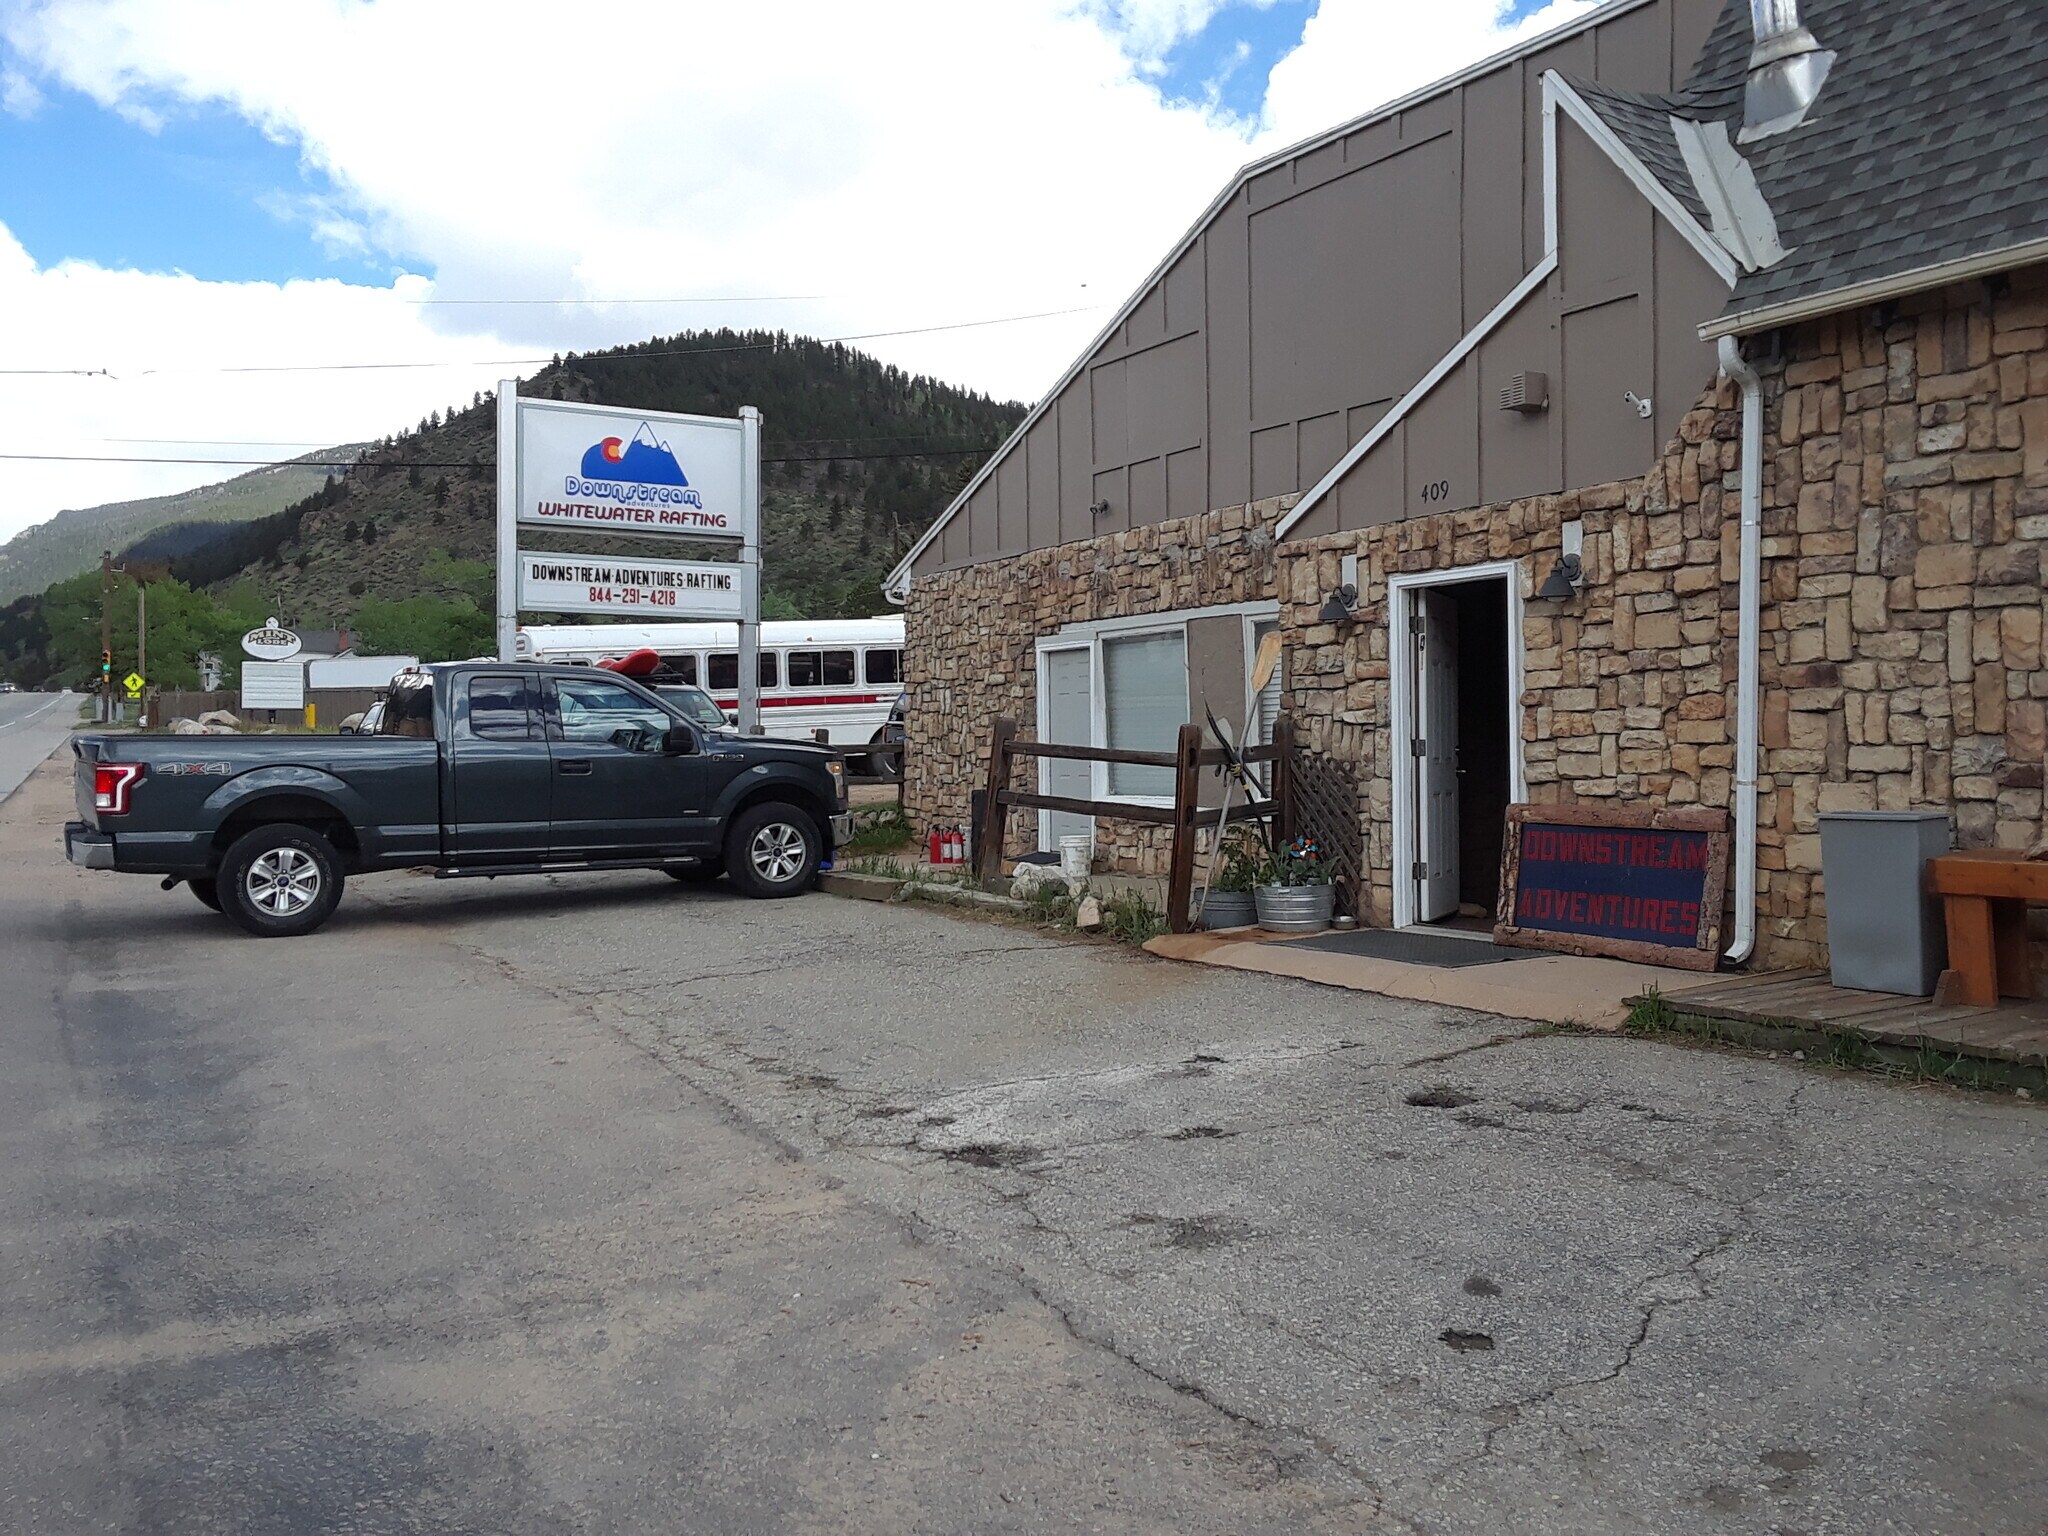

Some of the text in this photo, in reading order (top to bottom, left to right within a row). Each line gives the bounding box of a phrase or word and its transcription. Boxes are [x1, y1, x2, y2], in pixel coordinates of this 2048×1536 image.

[565, 475, 703, 509] Downstream
[626, 499, 671, 509] adventures
[1421, 480, 1449, 504] 409
[537, 501, 727, 528] WHITEWATER RAFTING
[532, 564, 731, 590] DOWNSTREAM ADVENTURES RAFTING
[589, 587, 676, 606] 844-291-4218
[248, 629, 296, 644] MINT
[256, 638, 288, 646] LODE
[1523, 830, 1709, 871] DOWNSTREAM
[1517, 887, 1701, 936] ADVENTURES
